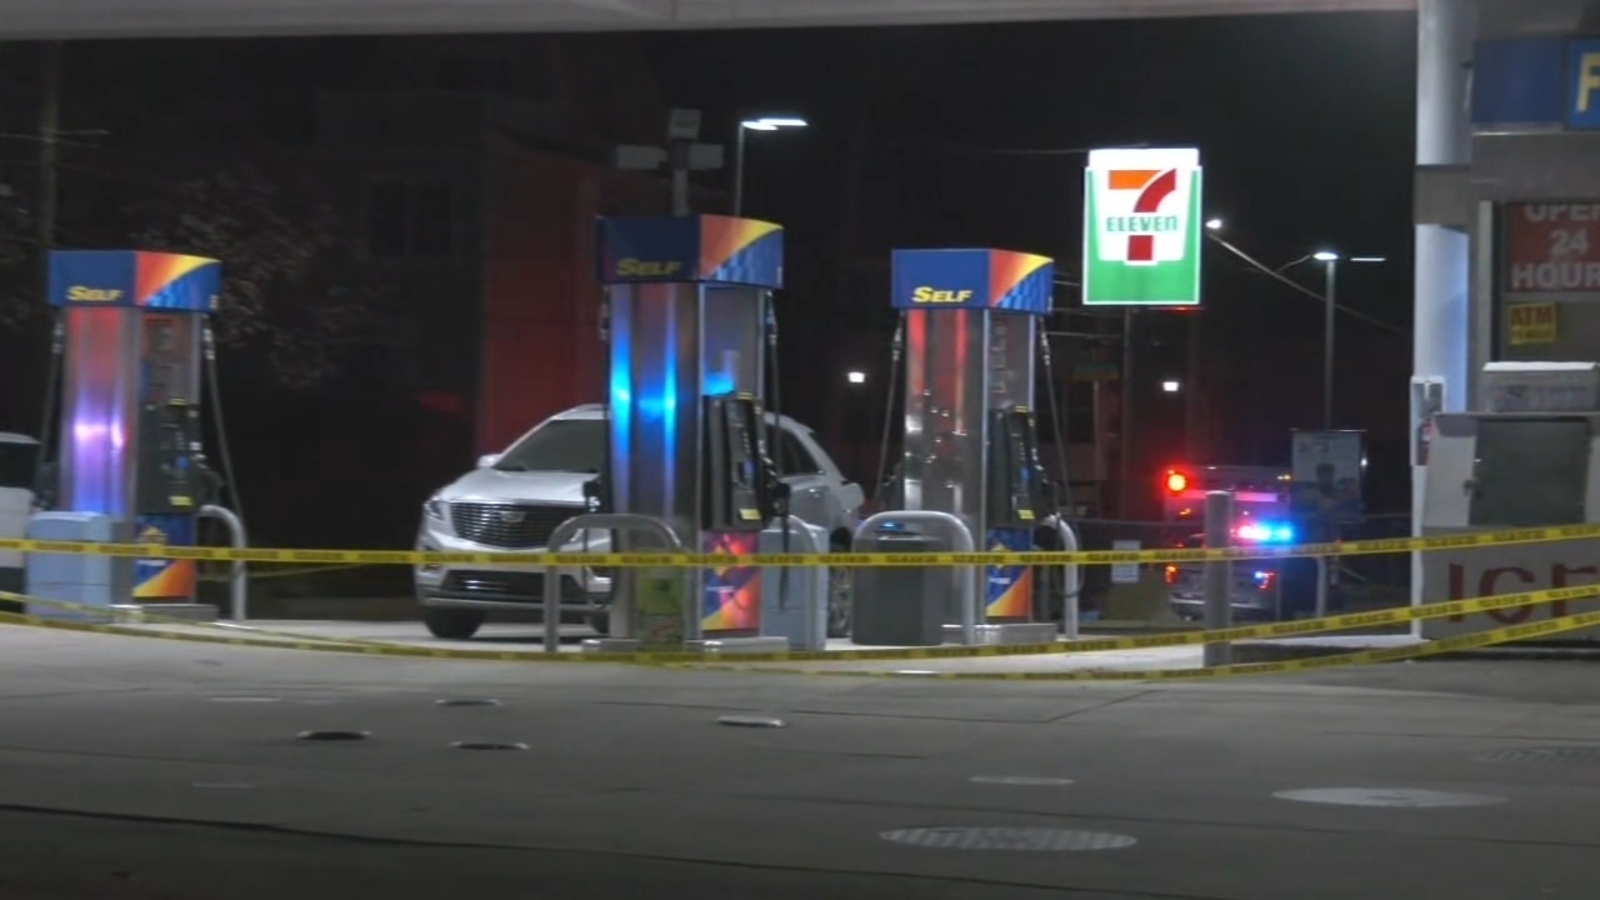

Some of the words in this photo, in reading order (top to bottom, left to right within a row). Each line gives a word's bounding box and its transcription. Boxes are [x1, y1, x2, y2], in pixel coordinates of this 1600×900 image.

[1108, 168, 1176, 261] 7
[1523, 203, 1600, 221] OPE
[1551, 229, 1589, 255] 24
